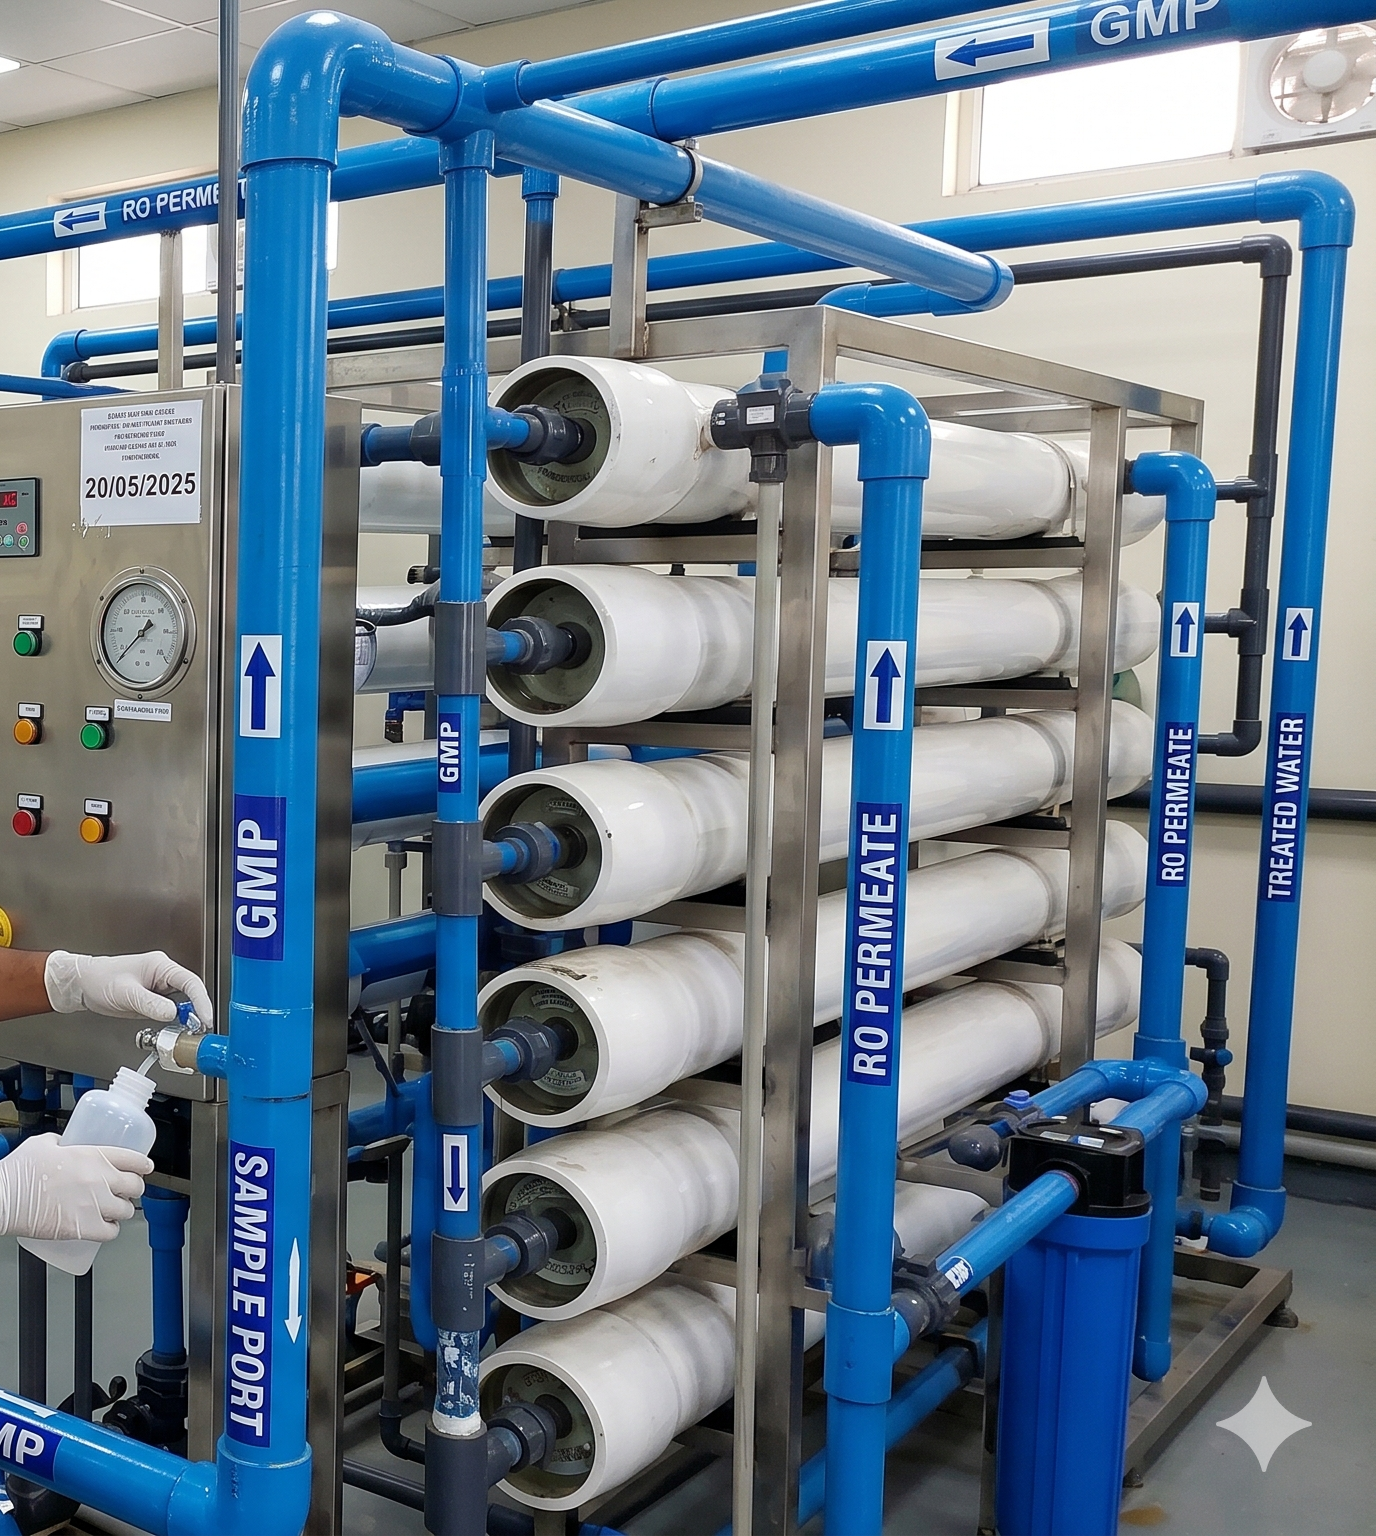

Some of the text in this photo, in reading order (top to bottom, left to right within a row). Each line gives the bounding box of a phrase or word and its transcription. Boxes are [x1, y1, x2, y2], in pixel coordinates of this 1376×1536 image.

[1090, 0, 1220, 46] GMP
[122, 196, 151, 221] RO
[85, 472, 196, 499] 20/05/2025
[439, 722, 459, 783] GMP
[1161, 728, 1193, 881] RO PERMEATE
[1267, 718, 1304, 899] TREATED WATER
[235, 819, 278, 938] GMP
[853, 813, 897, 1077] RO PERMEATE
[230, 1151, 269, 1438] SAMPLE PORT
